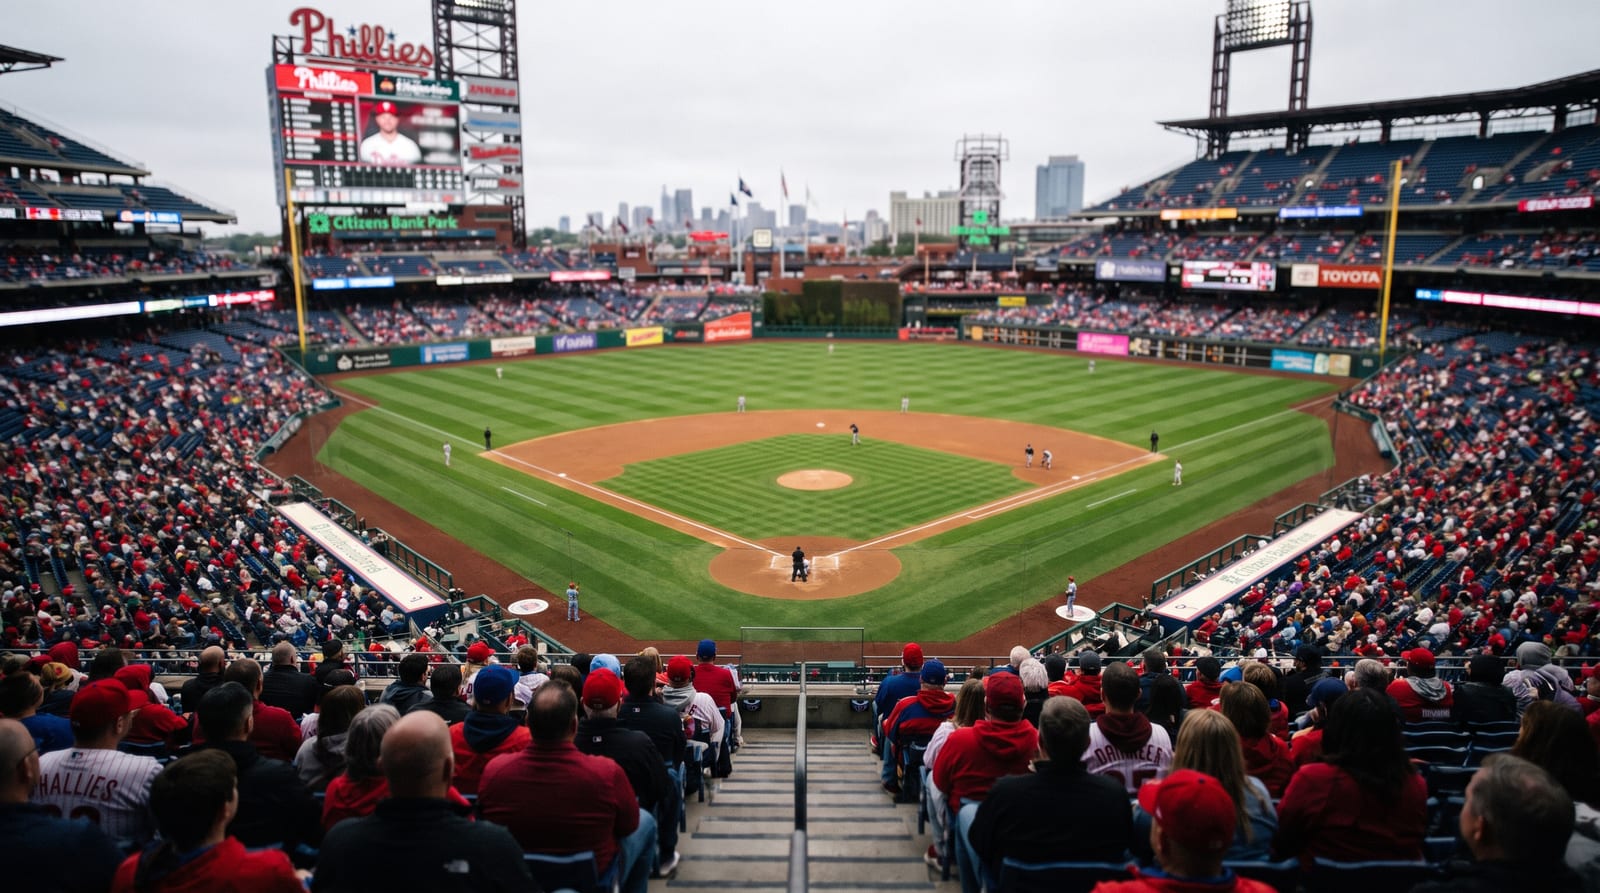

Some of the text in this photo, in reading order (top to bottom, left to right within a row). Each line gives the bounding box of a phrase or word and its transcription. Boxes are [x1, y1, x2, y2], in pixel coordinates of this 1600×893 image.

[289, 7, 435, 67] Phillies
[293, 67, 359, 93] Phillies
[333, 215, 459, 230] Citizens Bank Park
[1321, 269, 1380, 284] TOYOTA
